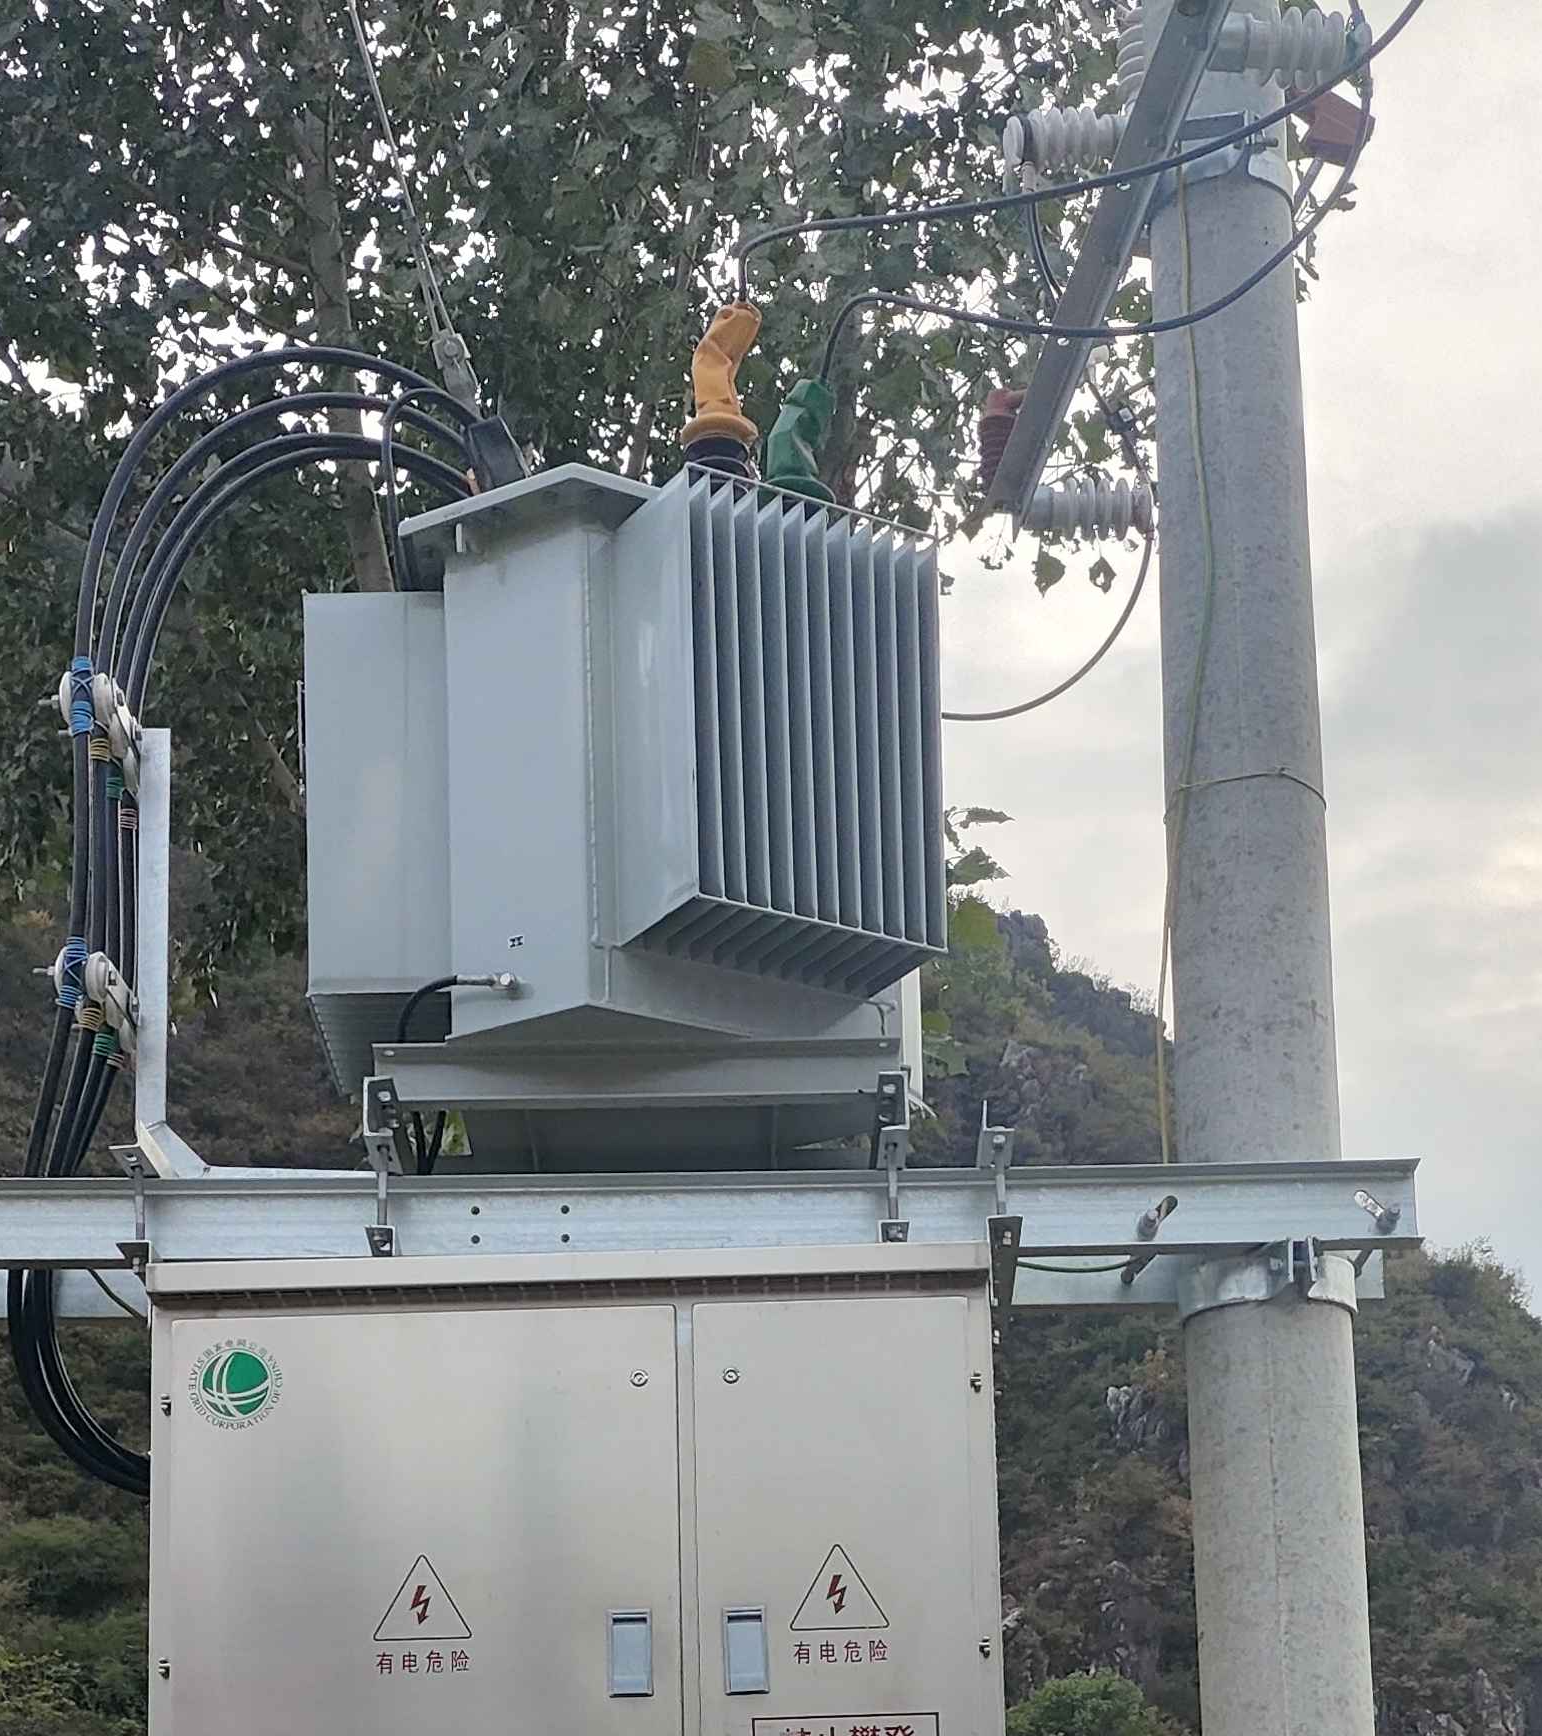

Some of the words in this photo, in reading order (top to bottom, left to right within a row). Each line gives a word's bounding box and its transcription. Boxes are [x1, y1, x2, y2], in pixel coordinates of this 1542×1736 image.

[376, 1649, 470, 1675] 有电危险
[793, 1639, 888, 1665] 有电危险
